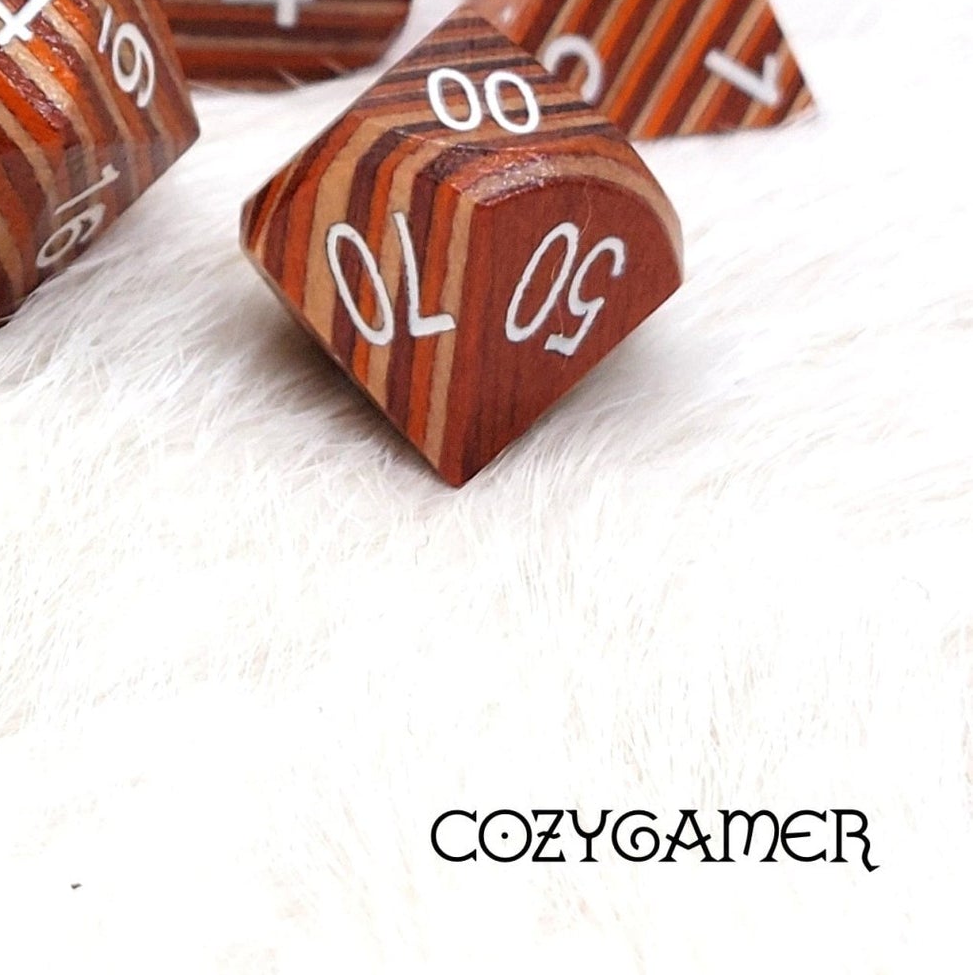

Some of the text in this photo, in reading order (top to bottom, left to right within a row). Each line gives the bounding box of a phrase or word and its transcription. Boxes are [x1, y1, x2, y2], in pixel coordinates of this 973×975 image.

[427, 67, 540, 133] 00
[704, 47, 781, 106] 1
[327, 212, 455, 347] 70
[506, 222, 627, 356] 50
